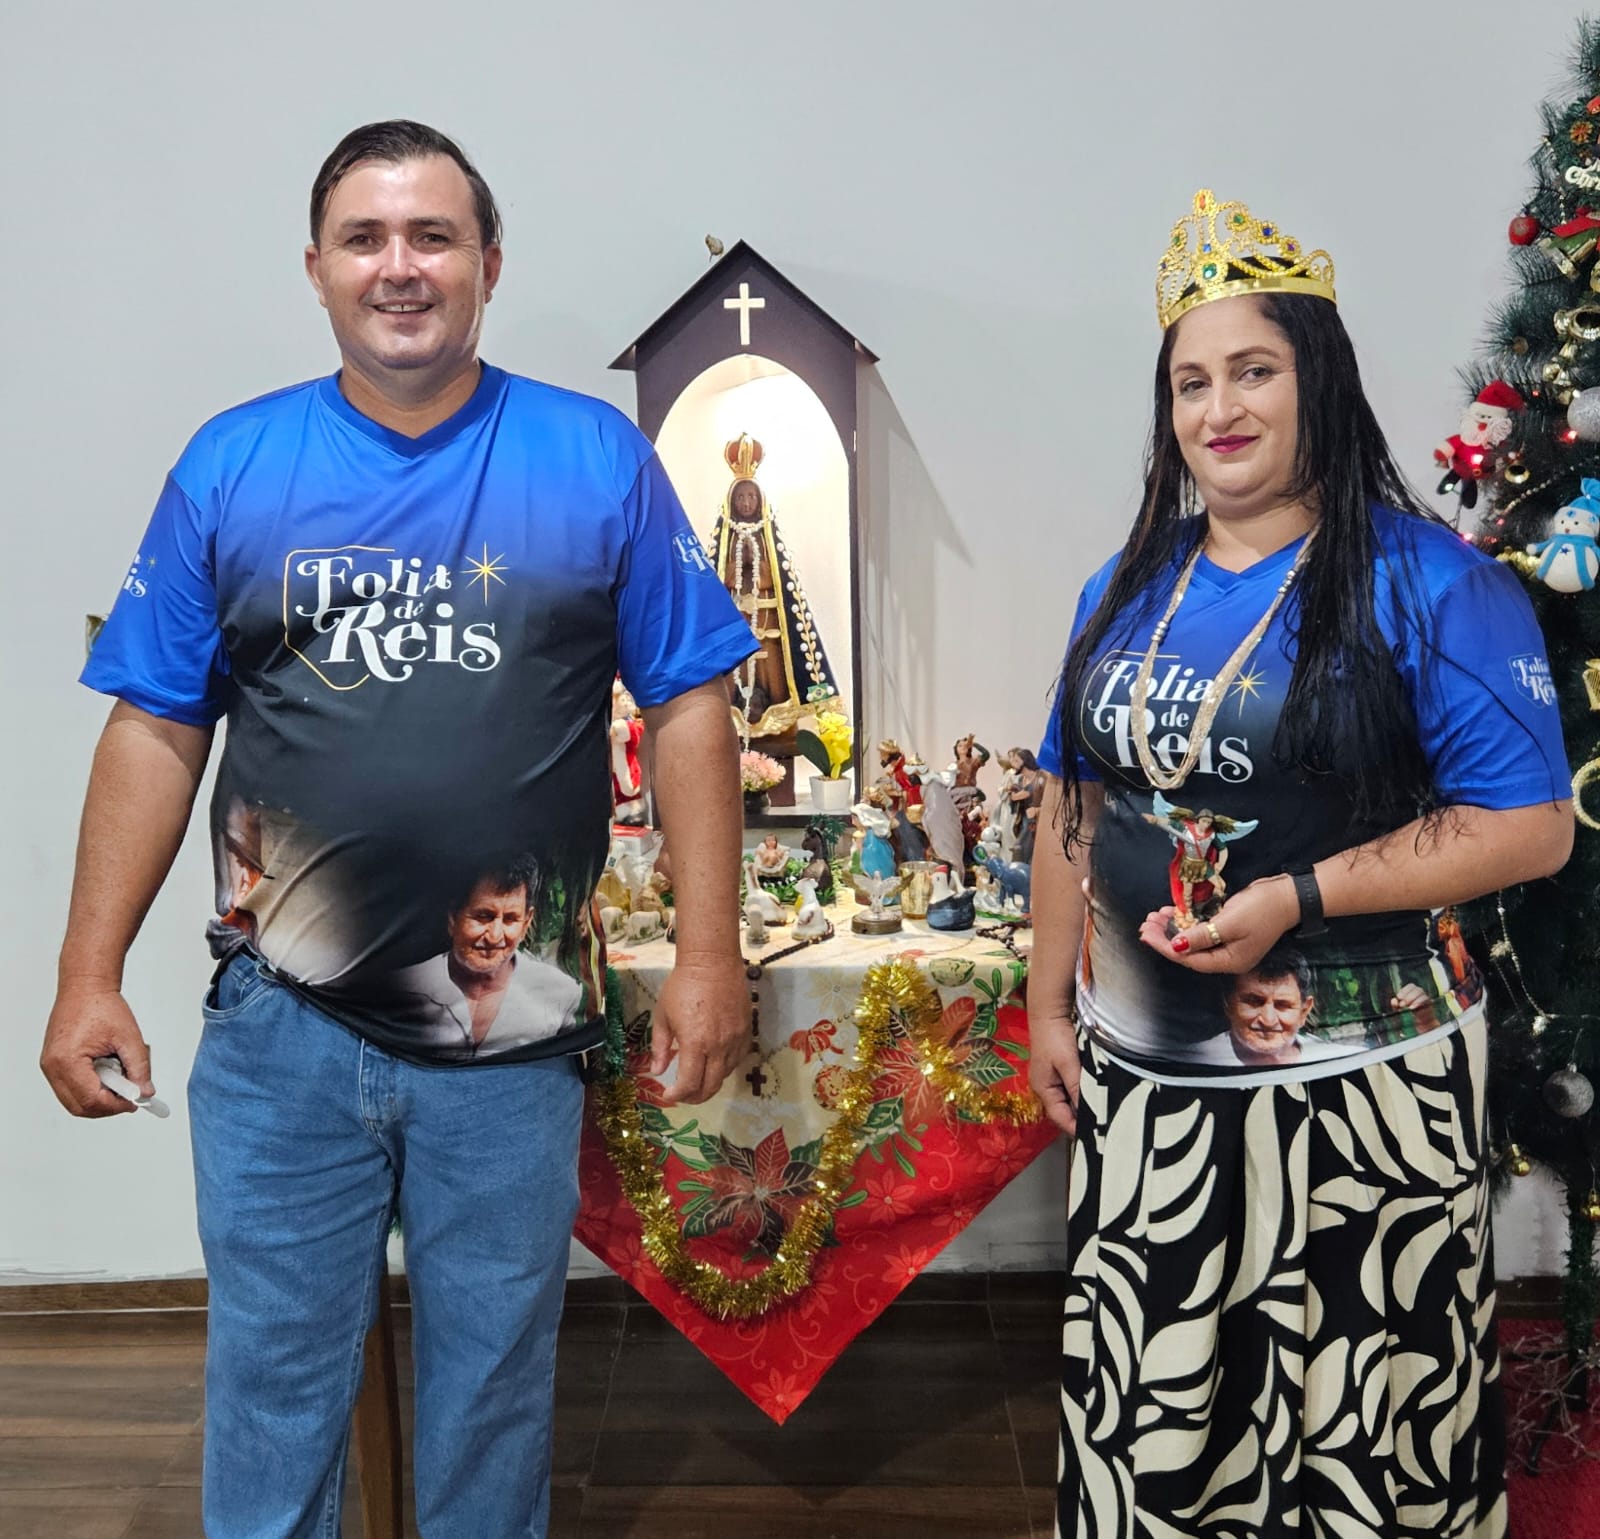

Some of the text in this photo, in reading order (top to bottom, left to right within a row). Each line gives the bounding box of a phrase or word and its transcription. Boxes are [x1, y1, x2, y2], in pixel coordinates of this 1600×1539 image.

[296, 556, 453, 617] Folia
[312, 600, 501, 682] Reis
[1160, 703, 1190, 728] de
